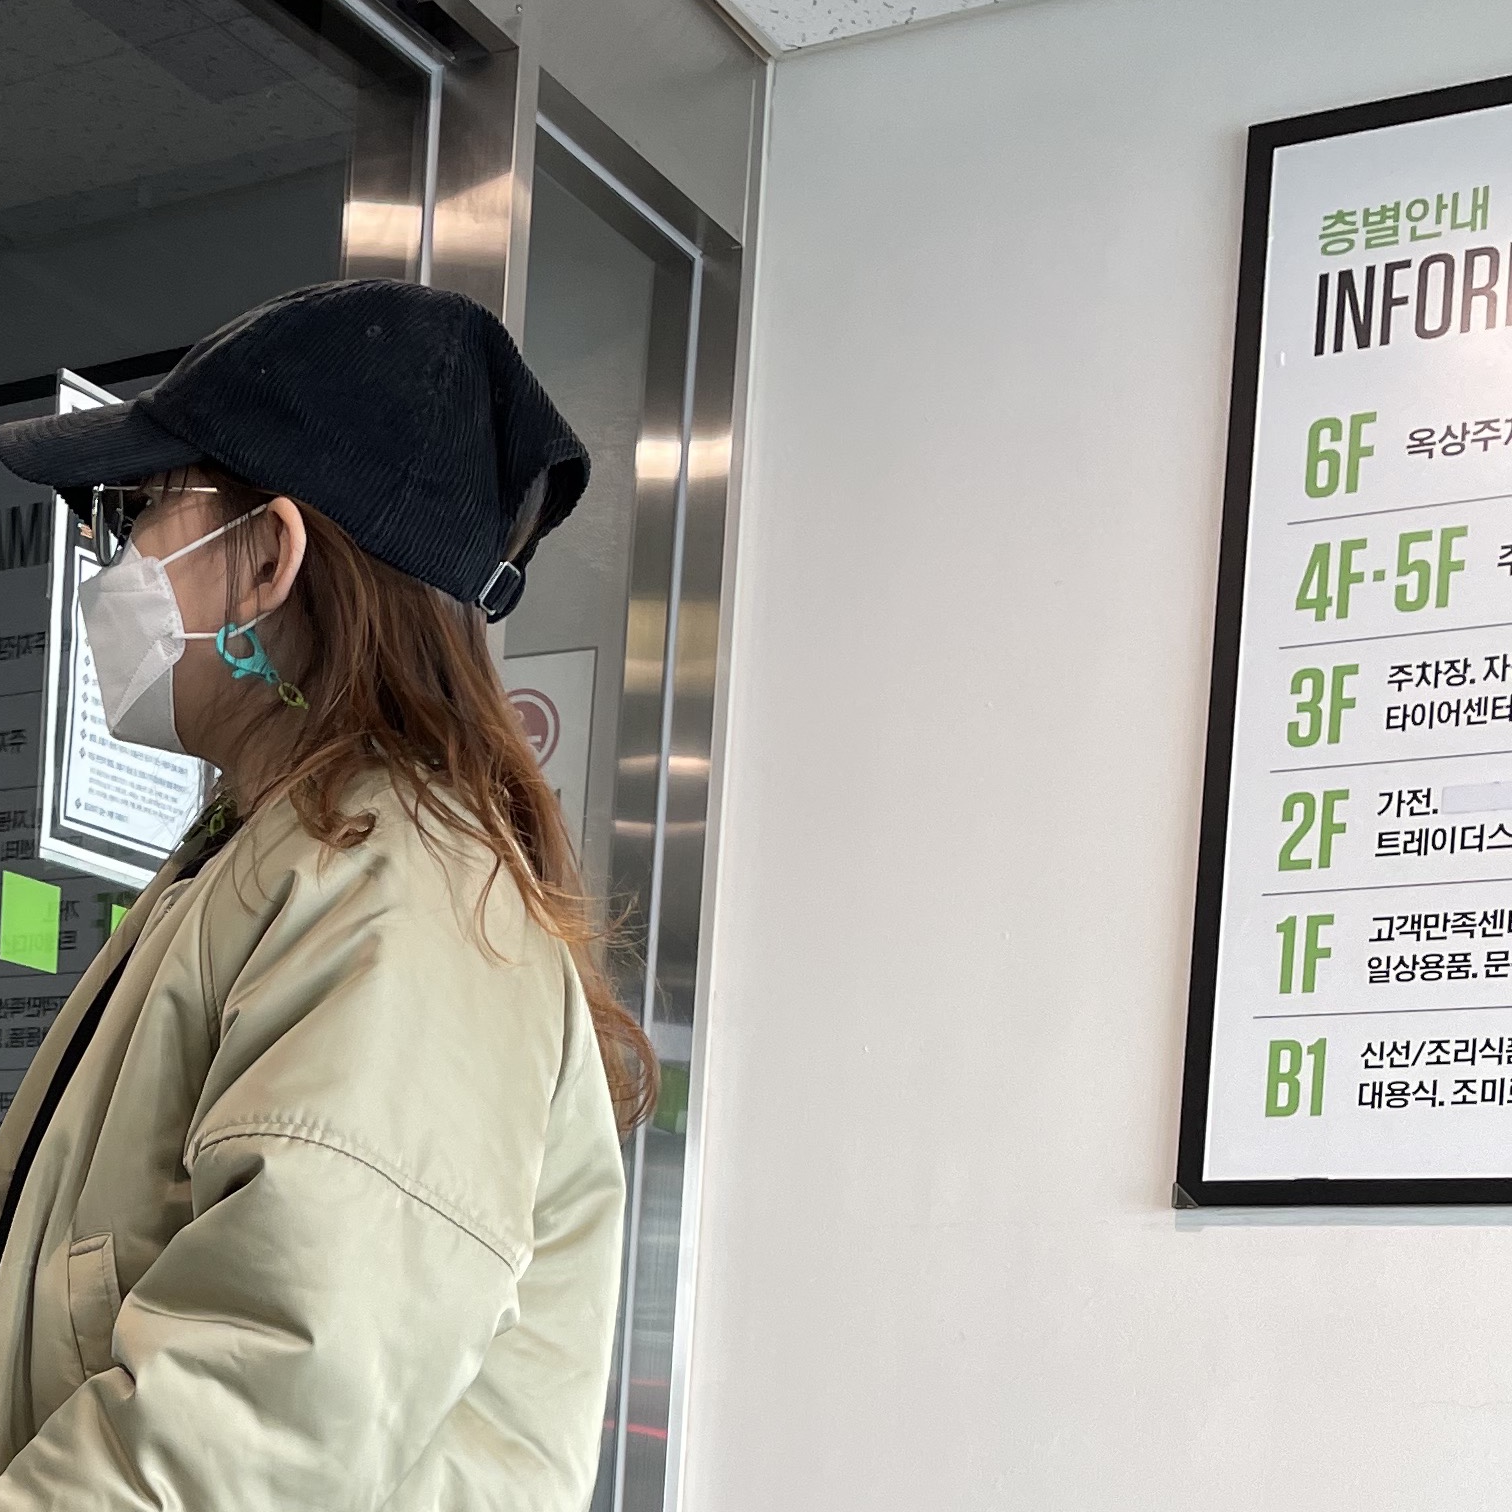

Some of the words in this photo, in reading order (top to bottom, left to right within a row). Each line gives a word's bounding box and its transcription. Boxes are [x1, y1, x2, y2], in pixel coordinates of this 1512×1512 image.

[1318, 185, 1490, 257] 층별안내
[1314, 241, 1512, 357] INFOR
[1304, 411, 1377, 499] 6F
[1287, 663, 1360, 748] 3F
[1278, 789, 1350, 872] 2F
[1375, 823, 1512, 857] 트레이더스
[1276, 914, 1334, 994] 1F
[1368, 908, 1512, 943] 고객만족센
[1265, 1037, 1327, 1117] B1
[1360, 1037, 1512, 1069] 신선/조리식
[1451, 1078, 1512, 1106] 조미
